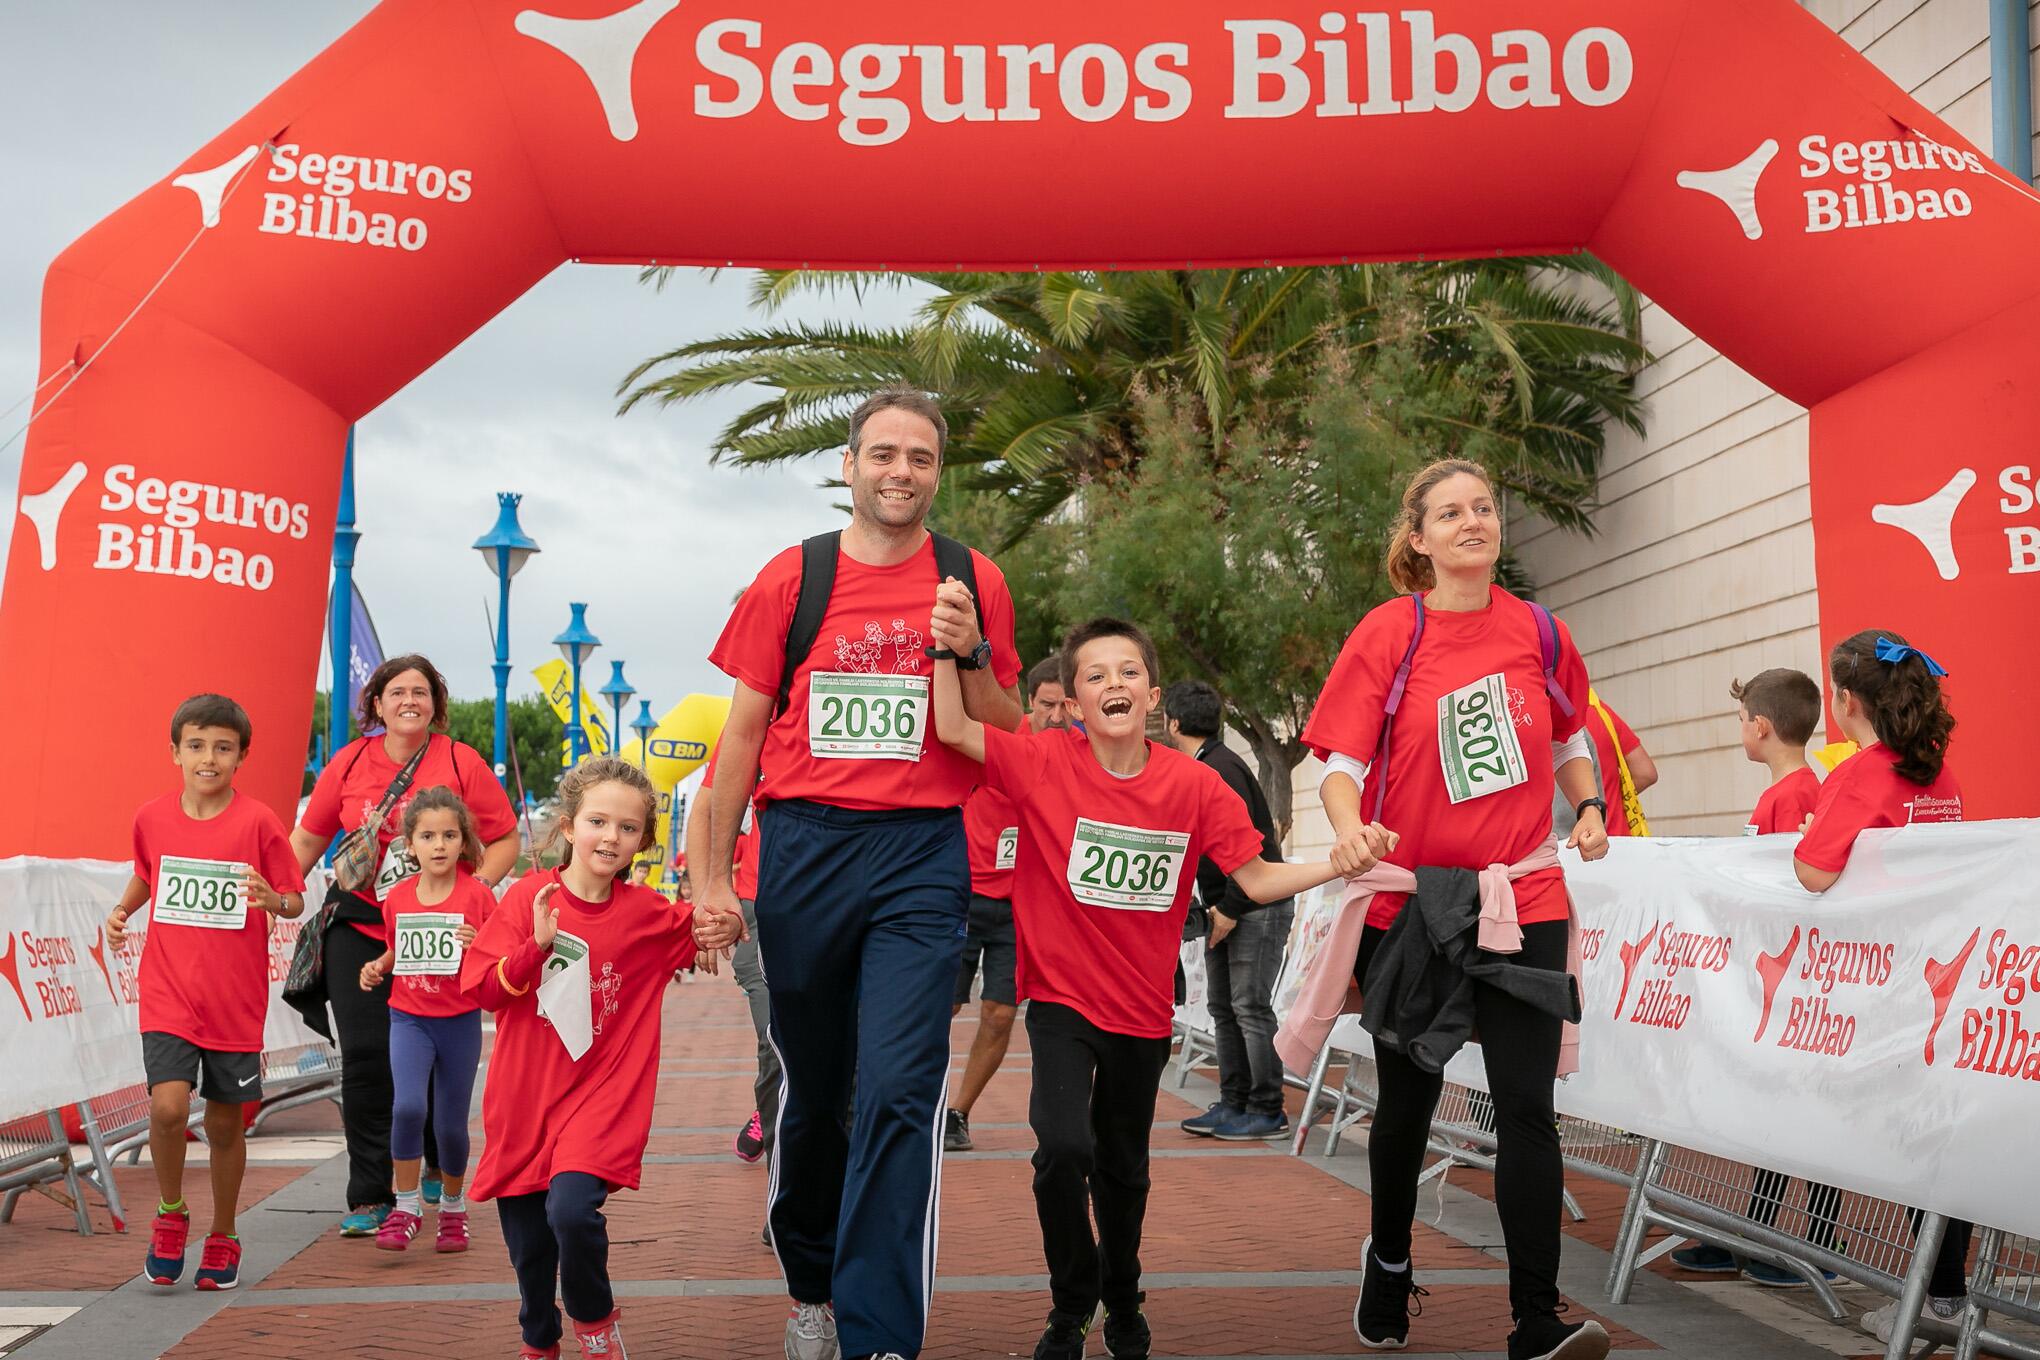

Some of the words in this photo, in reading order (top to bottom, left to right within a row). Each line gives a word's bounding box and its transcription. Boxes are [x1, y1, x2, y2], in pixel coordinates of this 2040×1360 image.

[694, 18, 1192, 146] Seguros
[1223, 9, 1634, 119] Bilbao
[267, 144, 472, 202] Seguros
[1799, 135, 1987, 181] Seguros
[259, 192, 428, 251] Bilbao
[1803, 182, 1972, 233] Bilbao
[101, 464, 309, 540] Seguros
[1999, 465, 2040, 514] S
[93, 523, 274, 590] Bilbao
[821, 696, 916, 739] 2036
[1456, 690, 1507, 783] 2036
[166, 876, 238, 912] 2036
[1079, 845, 1172, 892] 2036
[400, 930, 454, 960] 2036
[1652, 919, 1732, 977] Seguros
[1801, 927, 1894, 994] Seguros
[1630, 978, 1691, 1030] Bilbao
[1777, 996, 1856, 1057] Bilbao
